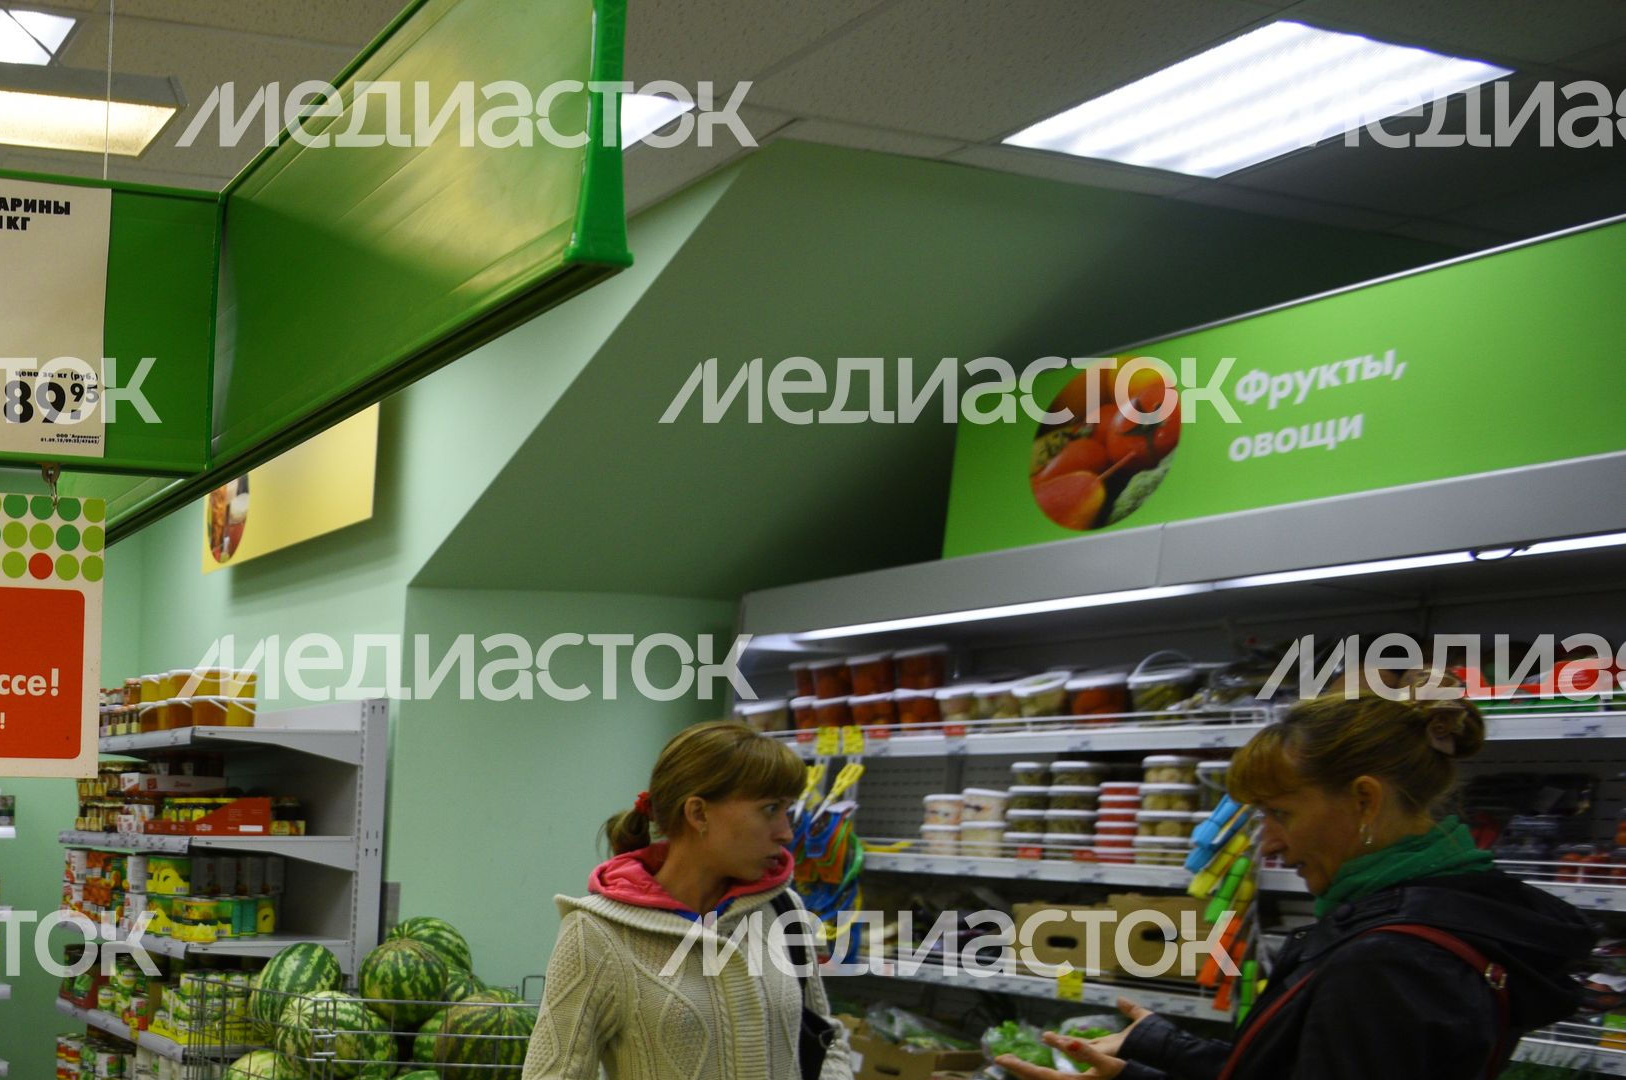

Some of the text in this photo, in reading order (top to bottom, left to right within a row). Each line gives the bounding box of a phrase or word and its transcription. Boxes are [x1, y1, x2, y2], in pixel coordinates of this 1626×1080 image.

[70, 371, 99, 381] (руб.)
[1234, 348, 1408, 410] Фрукты,
[1228, 413, 1365, 463] овощи
